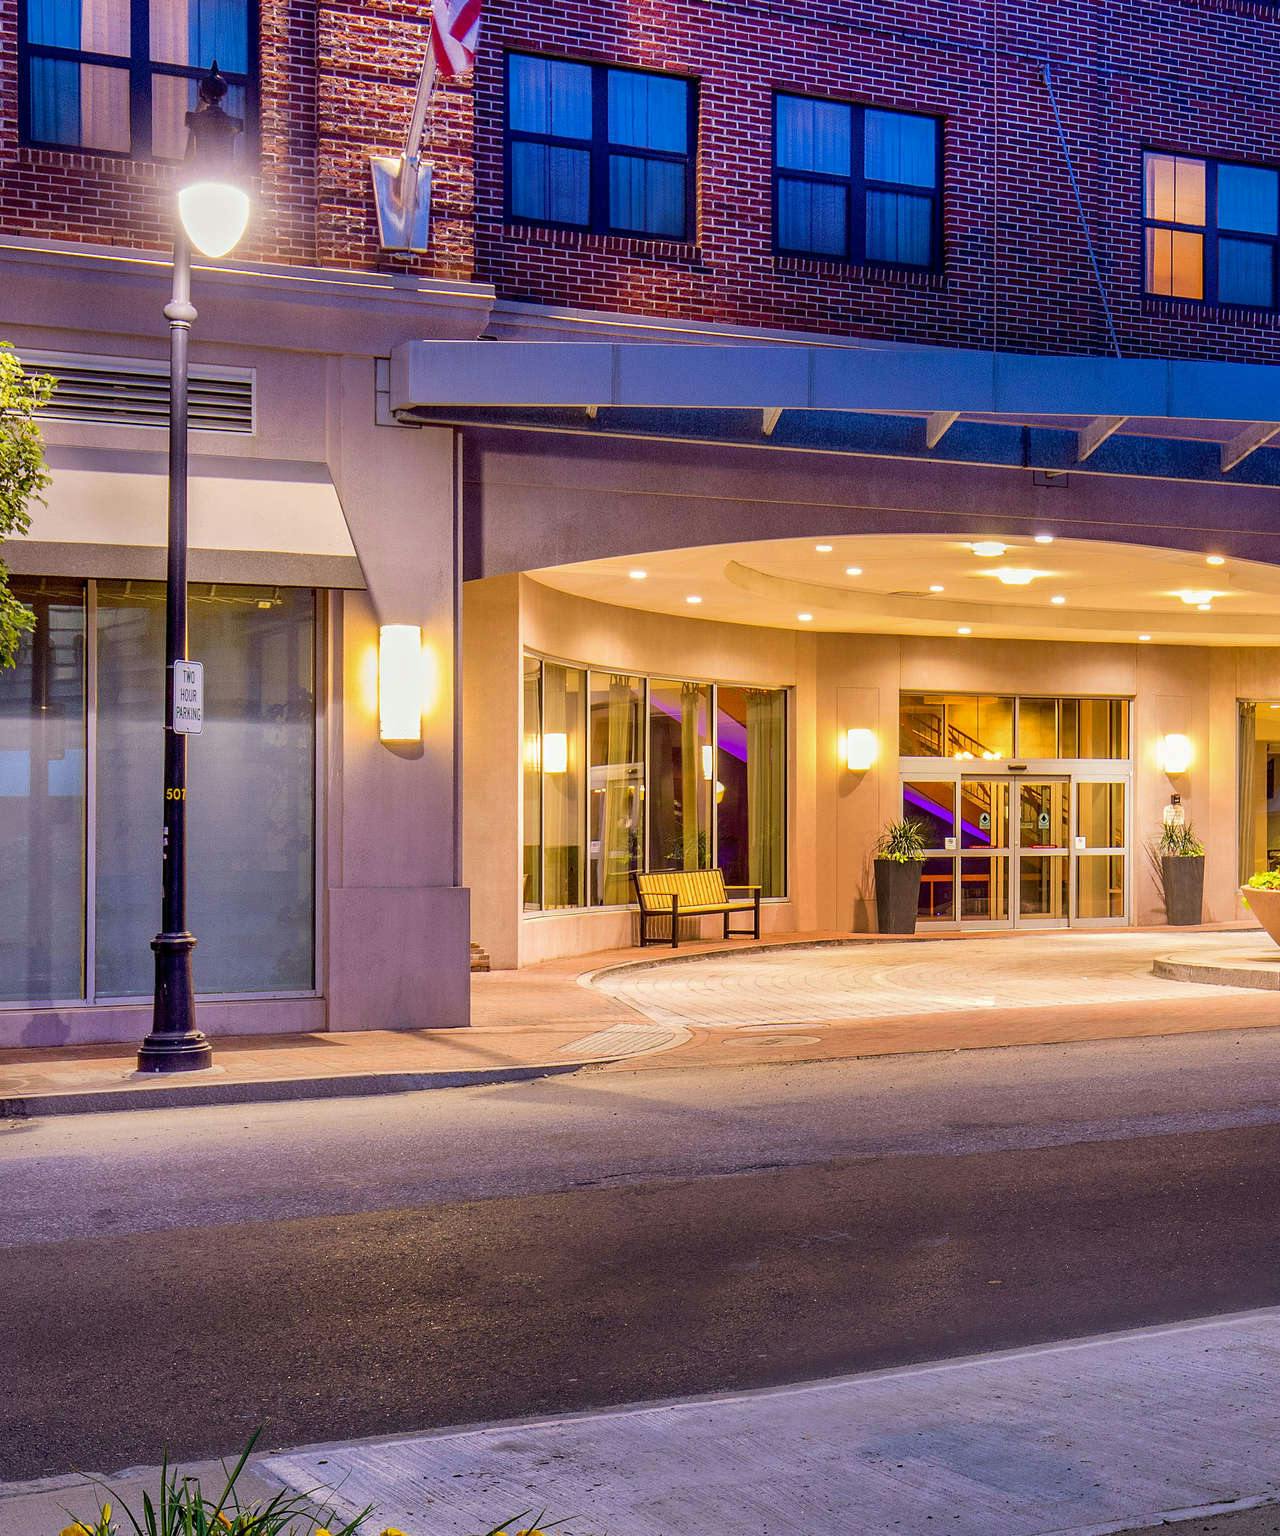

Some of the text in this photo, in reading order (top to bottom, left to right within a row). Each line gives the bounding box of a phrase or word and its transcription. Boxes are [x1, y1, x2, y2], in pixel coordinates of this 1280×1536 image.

[183, 669, 196, 684] TWO
[180, 687, 197, 702] HOUR
[176, 705, 201, 721] PARKING
